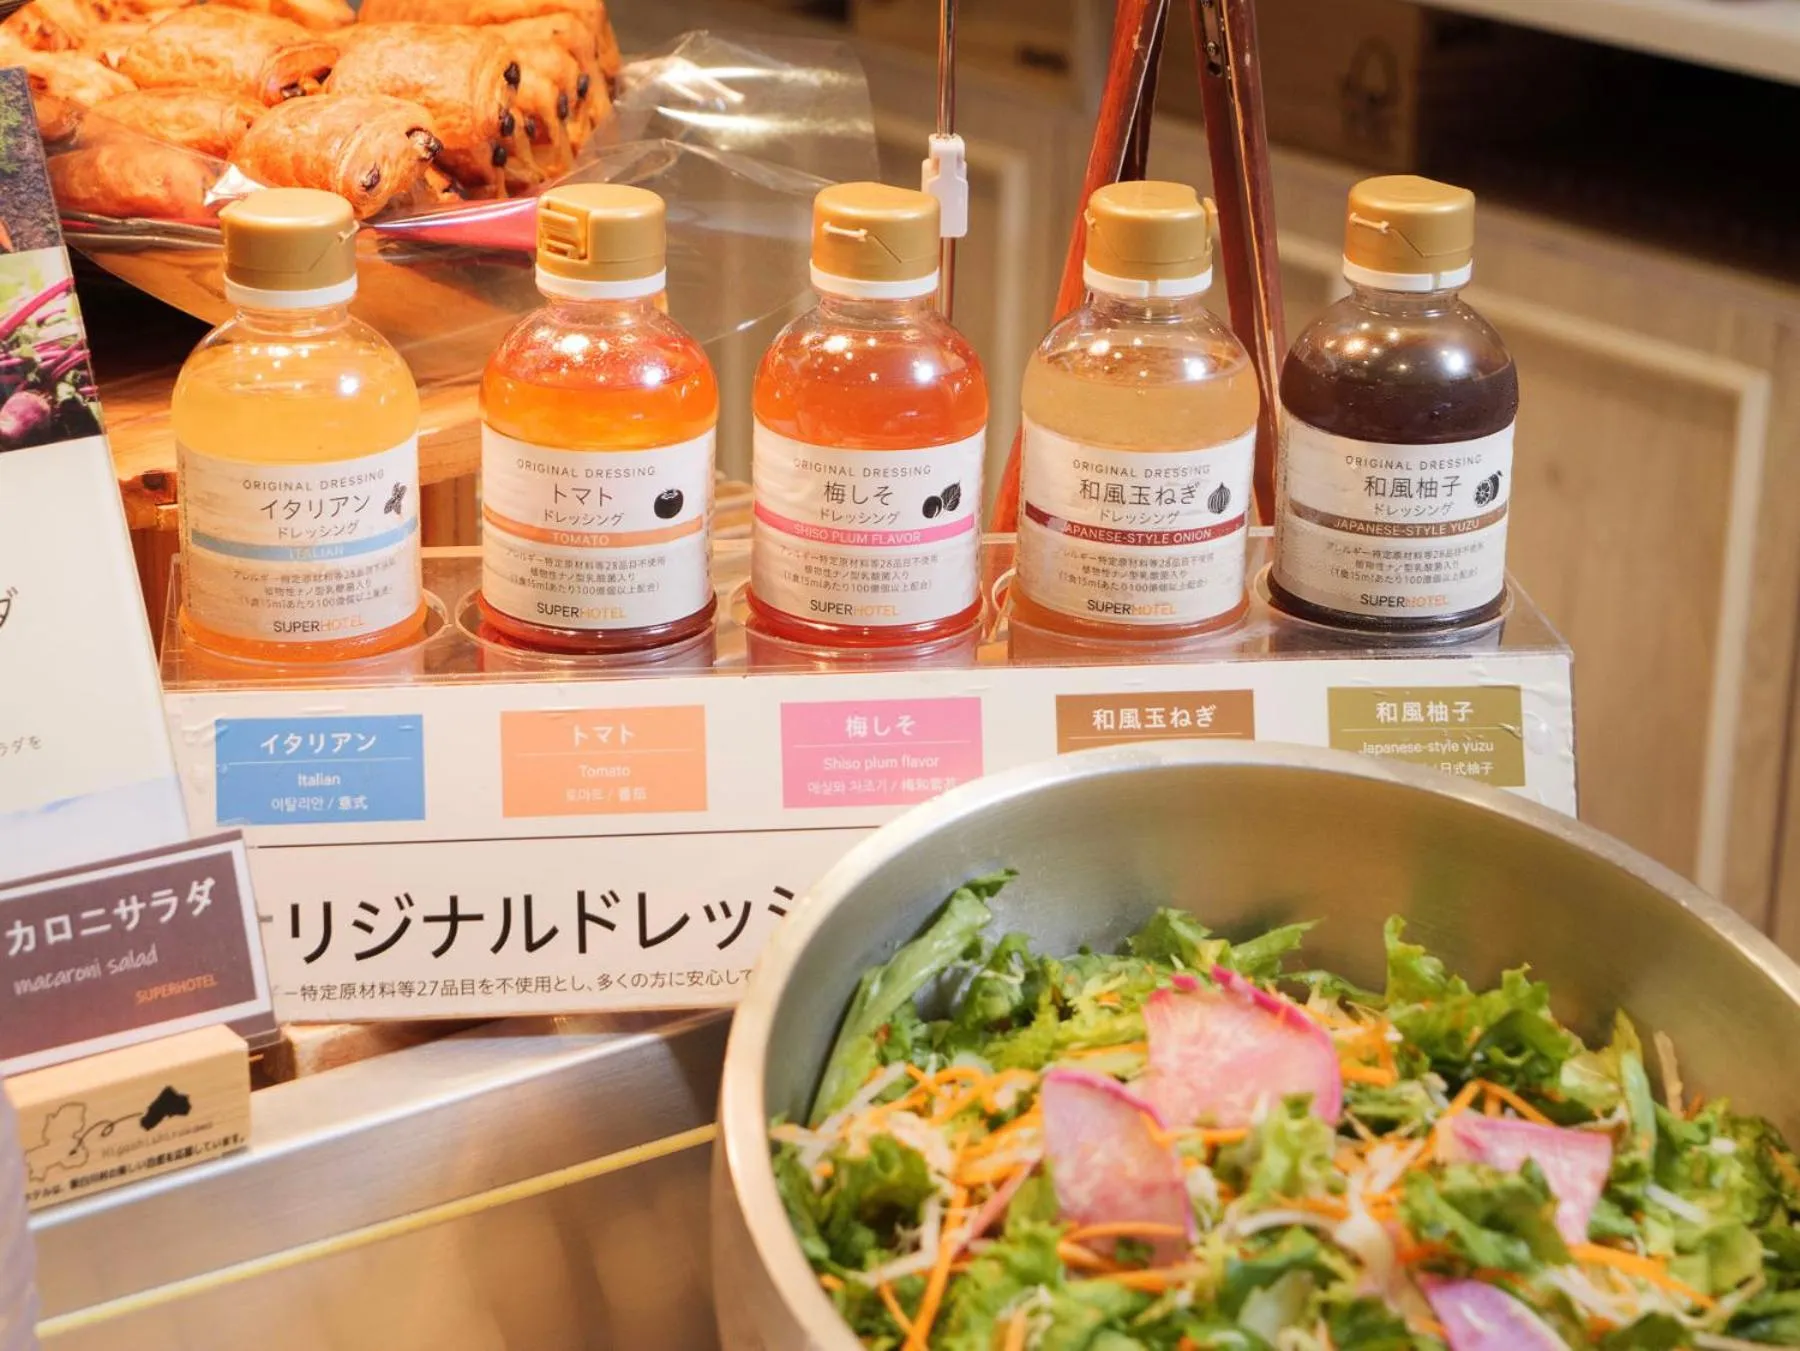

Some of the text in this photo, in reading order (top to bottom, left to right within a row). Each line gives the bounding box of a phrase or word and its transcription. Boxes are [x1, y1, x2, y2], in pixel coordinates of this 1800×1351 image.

[516, 458, 656, 479] ORIGINAL DRESSING
[793, 458, 932, 478] ORIGINAL DRESSING
[1072, 459, 1211, 479] ORIGINAL DRESSING
[1345, 454, 1483, 471] ORIGINAL DRESSING
[242, 469, 385, 492] ORIGINAL DRESSING
[1363, 474, 1462, 500] 和風柚子
[553, 483, 613, 507] トマト
[823, 481, 894, 506] 梅しそ
[1079, 478, 1200, 506] 和風玉ねぎ
[260, 495, 370, 521] イタリアン
[543, 508, 625, 527] ドレッシング
[819, 510, 900, 525] ドレッシング
[1099, 510, 1181, 525] ドレッシング
[1374, 502, 1454, 518] ドレッシング
[277, 519, 361, 540] ドレッシング
[793, 523, 921, 544] SHISO PLUM FLAVOR
[1173, 528, 1212, 544] ONION
[1333, 518, 1480, 537] JAPANESE-STYLE YUZU
[553, 532, 610, 546] TOMATO
[289, 546, 344, 561] ITALIAN
[536, 602, 628, 619] SUPERHOTEL
[810, 599, 900, 616] SUPERHOTEL
[1087, 599, 1177, 616] SUPERHOTEL
[1360, 593, 1448, 609] SUPERHOTEL
[273, 616, 364, 634] SUPERHOTEL
[1092, 704, 1217, 731] 和風玉ねぎ
[1376, 701, 1474, 723] 和風柚子
[573, 723, 636, 747] トマト
[845, 714, 917, 739] 梅しそ
[260, 732, 376, 755] イタリアン
[1359, 740, 1494, 756] Japanese-style yuzu
[578, 764, 631, 778] Tomato
[823, 754, 940, 772] Shiso plum flavor
[1440, 761, 1494, 777] 日式柚子
[297, 772, 341, 787] Italian
[271, 796, 324, 813] 이탈리안
[5, 876, 216, 957] カロニサラダ
[258, 886, 795, 964] リジナルドレッ
[13, 942, 159, 996] macaroni salad
[135, 973, 219, 1006] SUPERHOTEL
[273, 968, 753, 1002] ー特定原材料等27品目を不使用とし、多くの方に安心して
